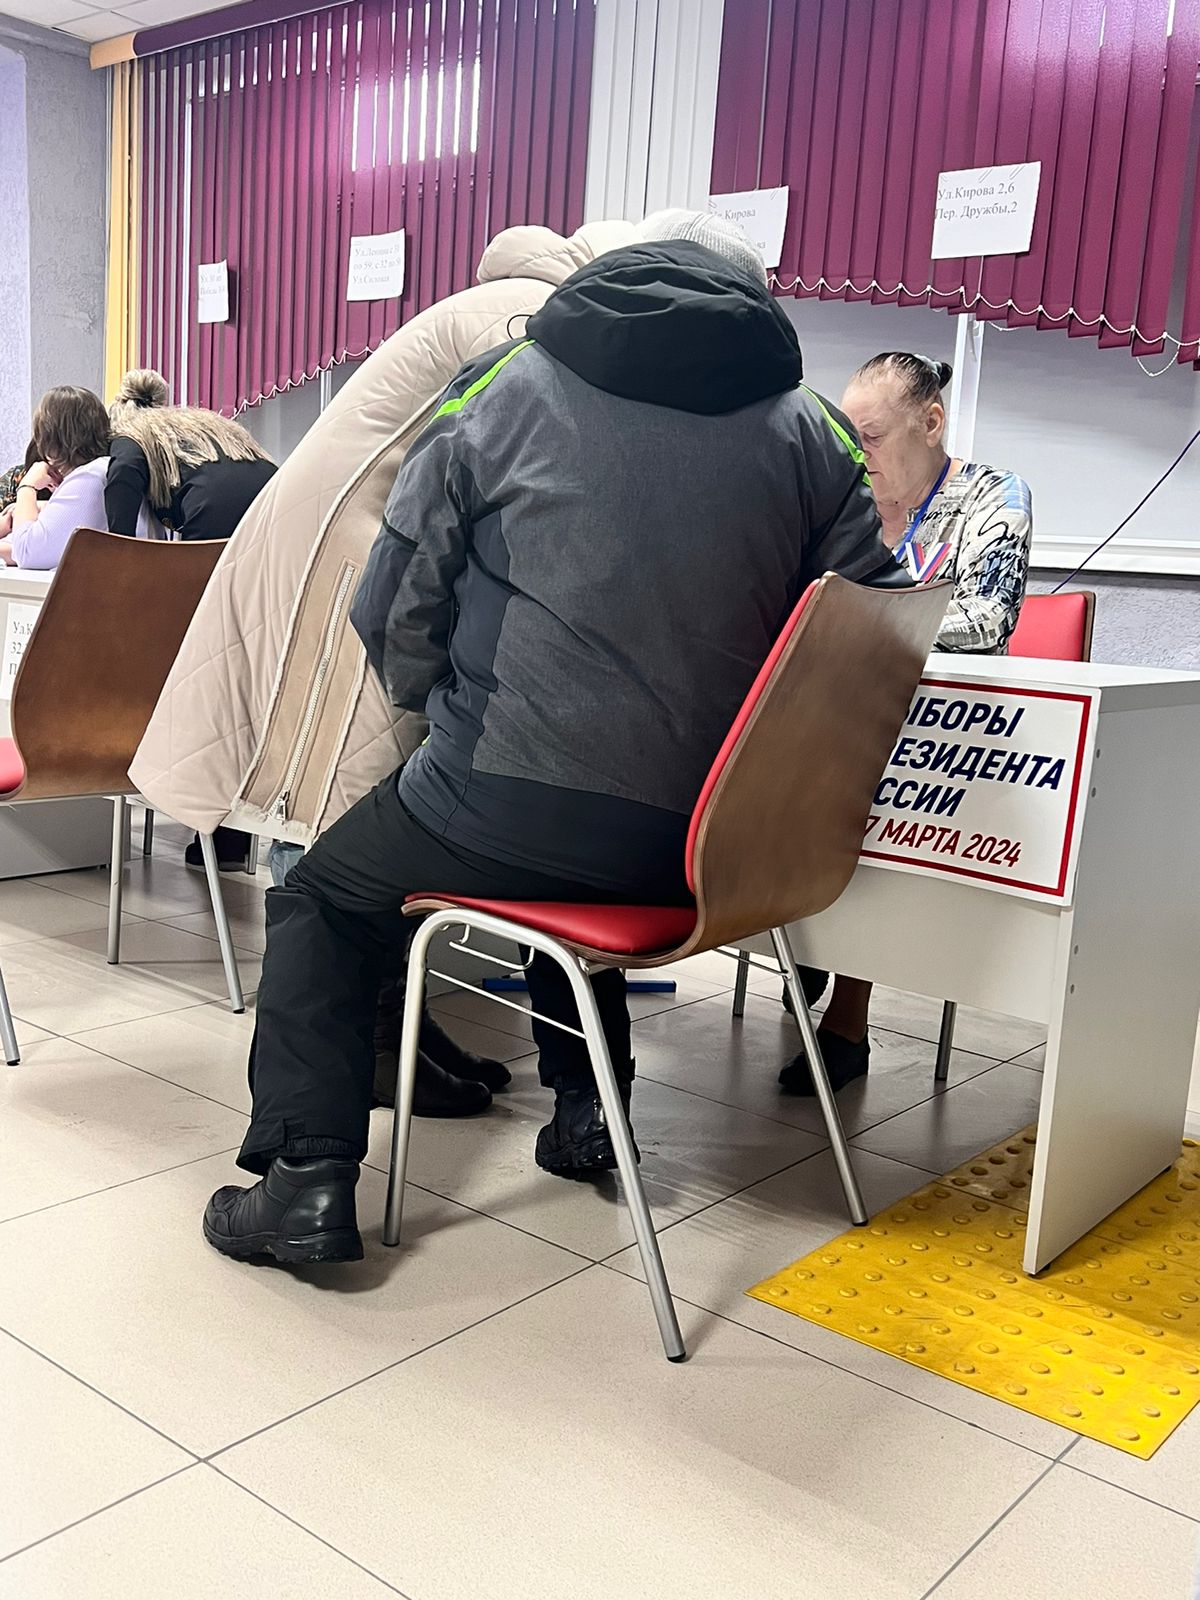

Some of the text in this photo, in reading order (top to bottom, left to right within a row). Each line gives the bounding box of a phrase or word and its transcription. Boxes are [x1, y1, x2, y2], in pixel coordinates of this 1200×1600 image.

[938, 181, 1015, 201] Ул.Кирова 2,6
[960, 201, 1018, 219] Дружбы,2
[13, 620, 33, 636] Ул.К
[890, 737, 1066, 790] ЕЗИДЕНТА
[872, 777, 967, 817] ССИИ
[863, 815, 1021, 868] 7 МАРТА 2024
